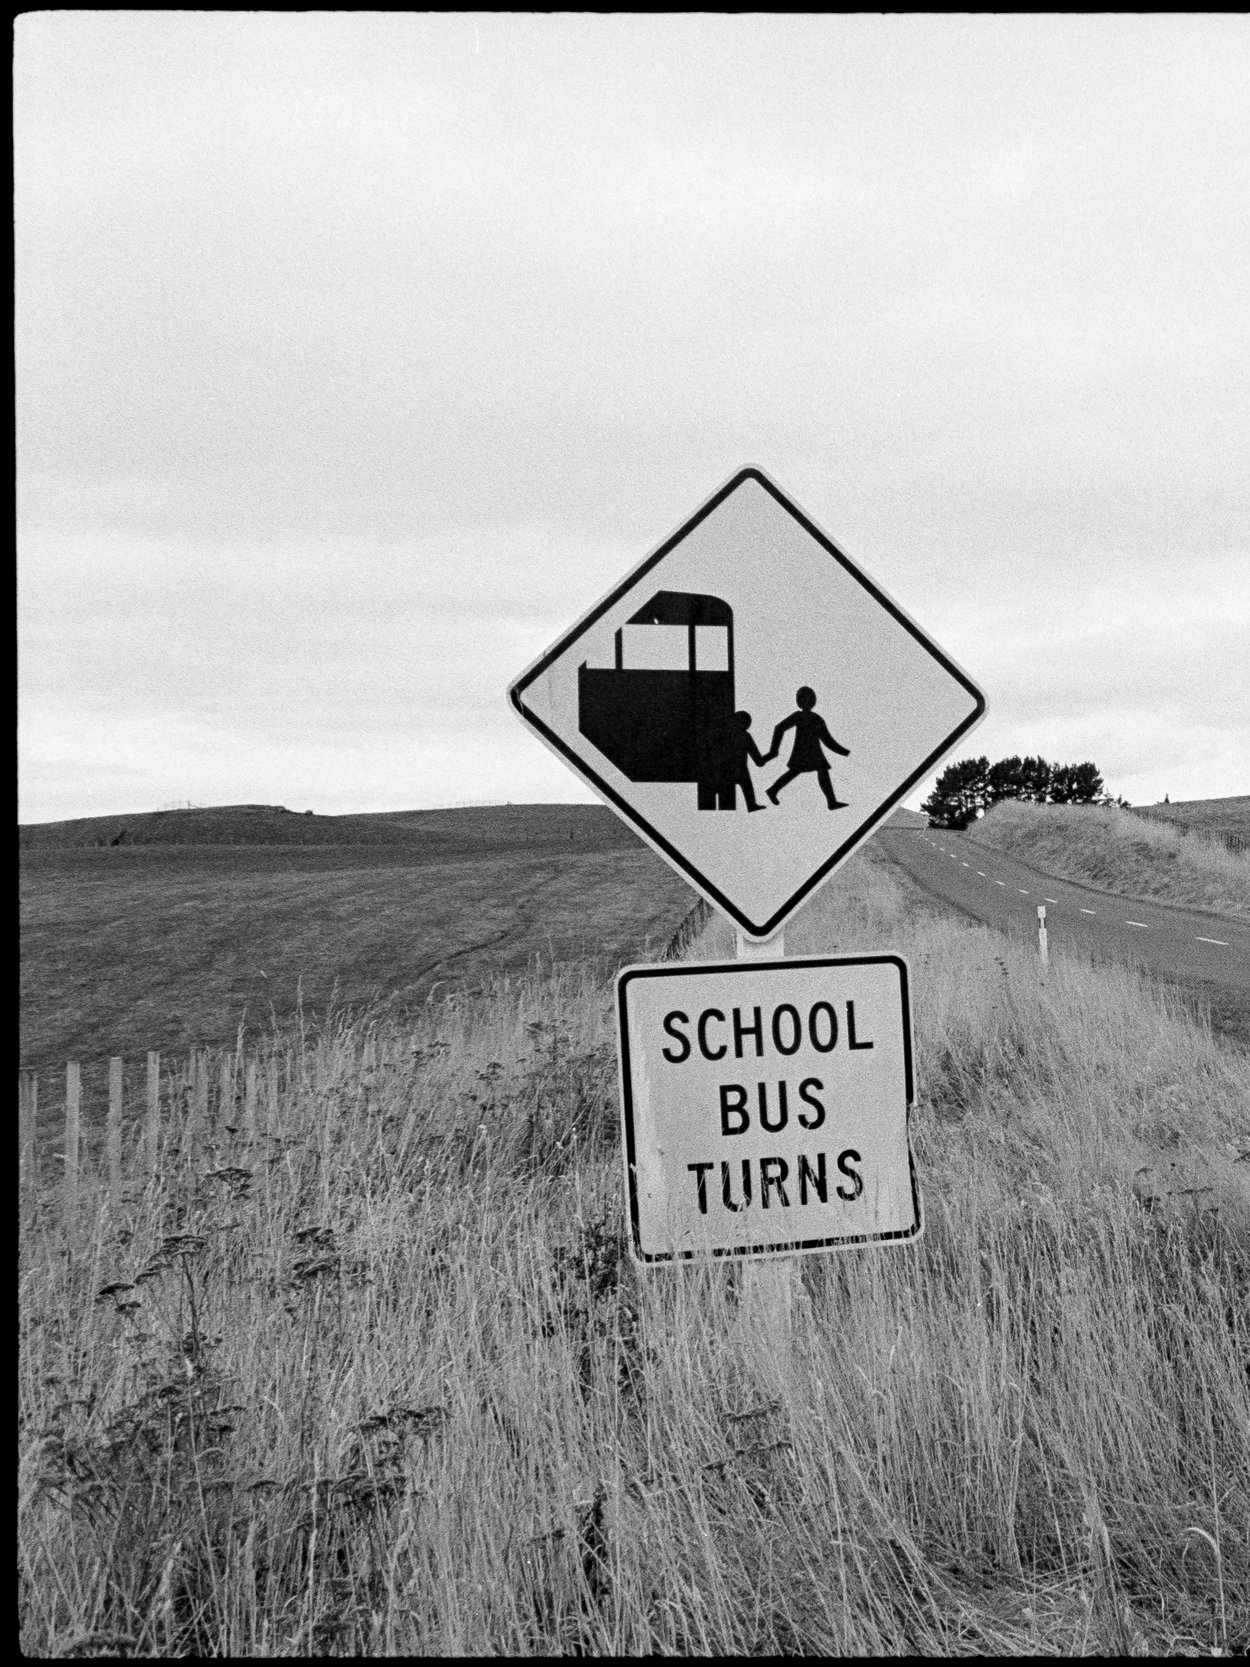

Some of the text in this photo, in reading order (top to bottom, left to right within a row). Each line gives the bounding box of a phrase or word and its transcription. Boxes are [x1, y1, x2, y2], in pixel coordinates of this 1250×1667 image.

[661, 1000, 874, 1064] SCHOOL
[719, 1077, 826, 1137] BUS
[686, 1149, 864, 1215] TURNS
